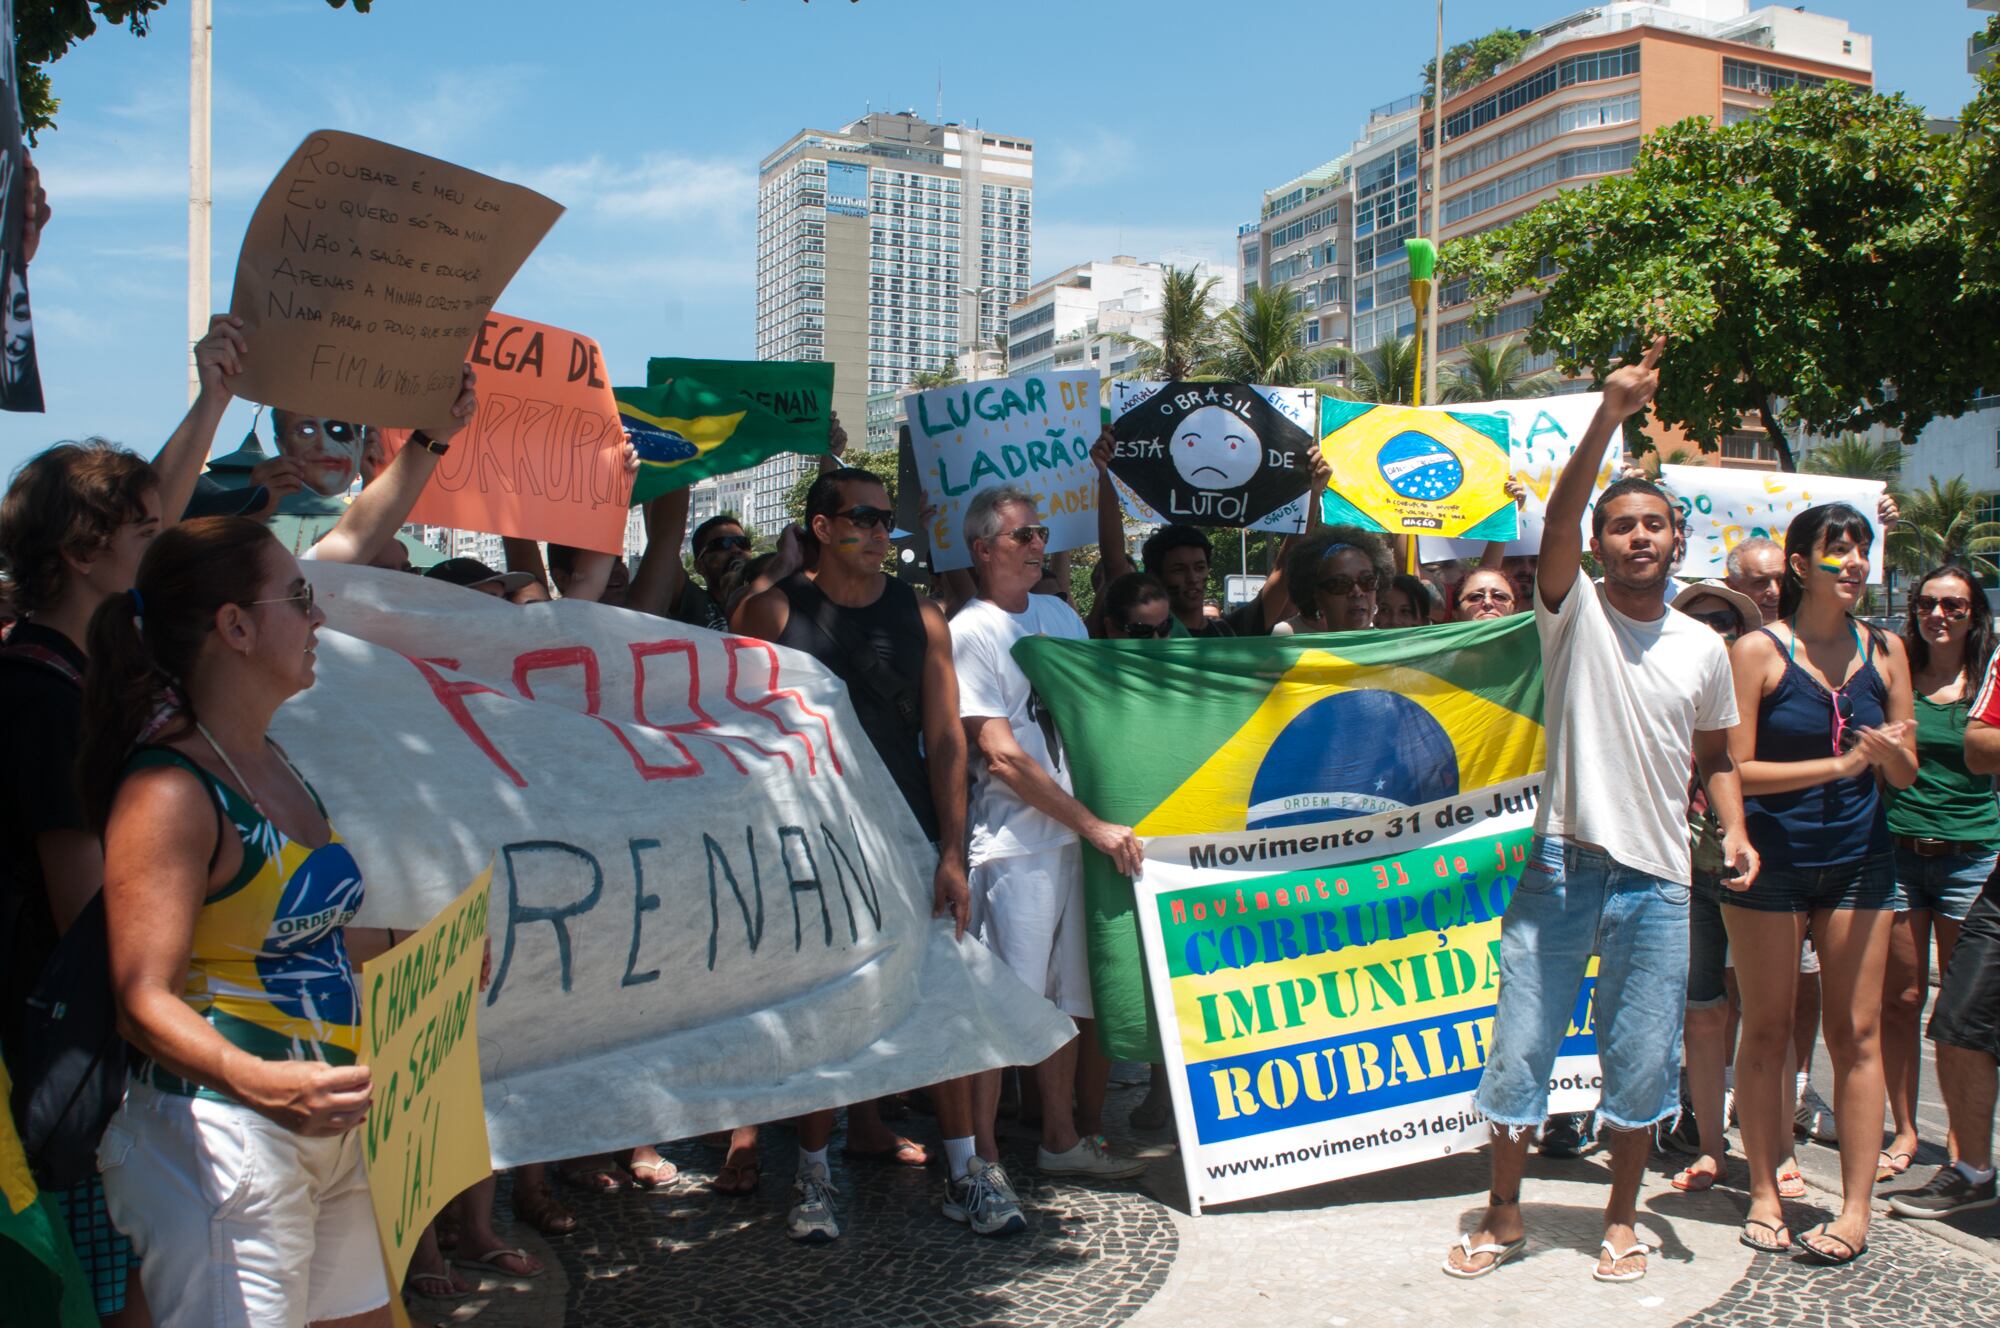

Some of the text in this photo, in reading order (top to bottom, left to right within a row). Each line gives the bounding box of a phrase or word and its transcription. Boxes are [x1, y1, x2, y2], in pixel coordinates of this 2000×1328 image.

[298, 137, 399, 187] ROUBAR
[411, 170, 426, 194] É
[433, 185, 465, 206] MEU
[281, 213, 340, 254] NÃO
[369, 249, 415, 269] SAÚDE
[420, 262, 430, 273] E
[340, 200, 399, 224] QUERO
[408, 213, 433, 229] SÓ
[434, 220, 459, 237] PRA
[272, 257, 354, 291] APENAS
[364, 283, 375, 297] A
[384, 283, 422, 307] MINHA
[268, 291, 322, 322] NADA
[330, 312, 361, 332] PARA
[367, 321, 377, 333] O
[310, 344, 368, 388] FIM
[567, 337, 605, 389] DE
[917, 377, 1089, 438] LUGAR DE
[1160, 386, 1252, 419] O BRASIL
[938, 428, 1089, 497] LADRÃO
[1114, 436, 1295, 469] ESTÁ DE
[1170, 488, 1248, 523] LUTO!
[1264, 501, 1299, 525] SAÚDE
[1284, 796, 1330, 810] ORDEM
[1341, 796, 1348, 808] E
[1189, 826, 1375, 870] Movimento
[1385, 811, 1421, 838] 31
[1434, 803, 1475, 828] de
[1170, 837, 1535, 924] Movimento 31 de ju
[487, 815, 882, 1008] RENAN
[1185, 871, 1519, 976] CORRUPÇÃO
[371, 924, 447, 1058] CHOQUE
[403, 976, 474, 1112] SENADO
